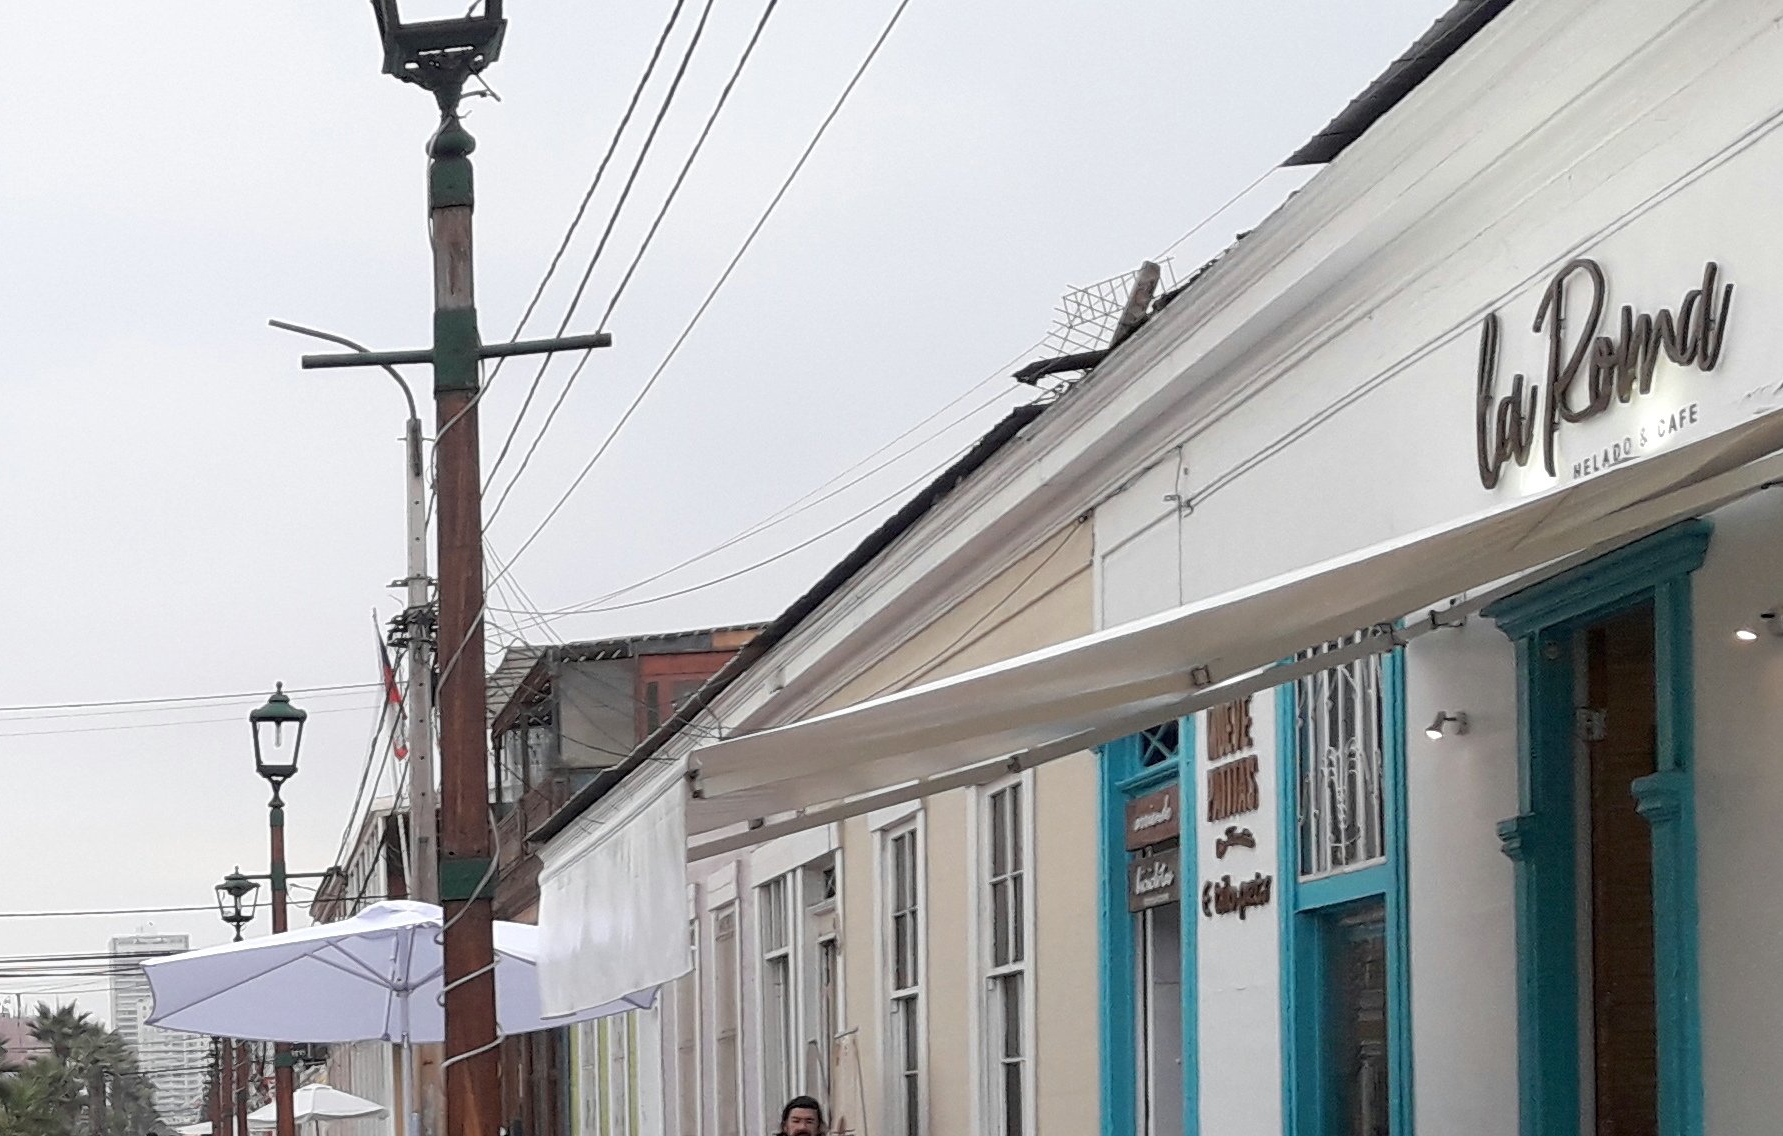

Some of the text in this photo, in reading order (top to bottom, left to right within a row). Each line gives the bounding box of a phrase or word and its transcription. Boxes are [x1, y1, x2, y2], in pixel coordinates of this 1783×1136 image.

[1533, 259, 1735, 478] Roma
[1573, 403, 1698, 479] HELADO & CAFE
